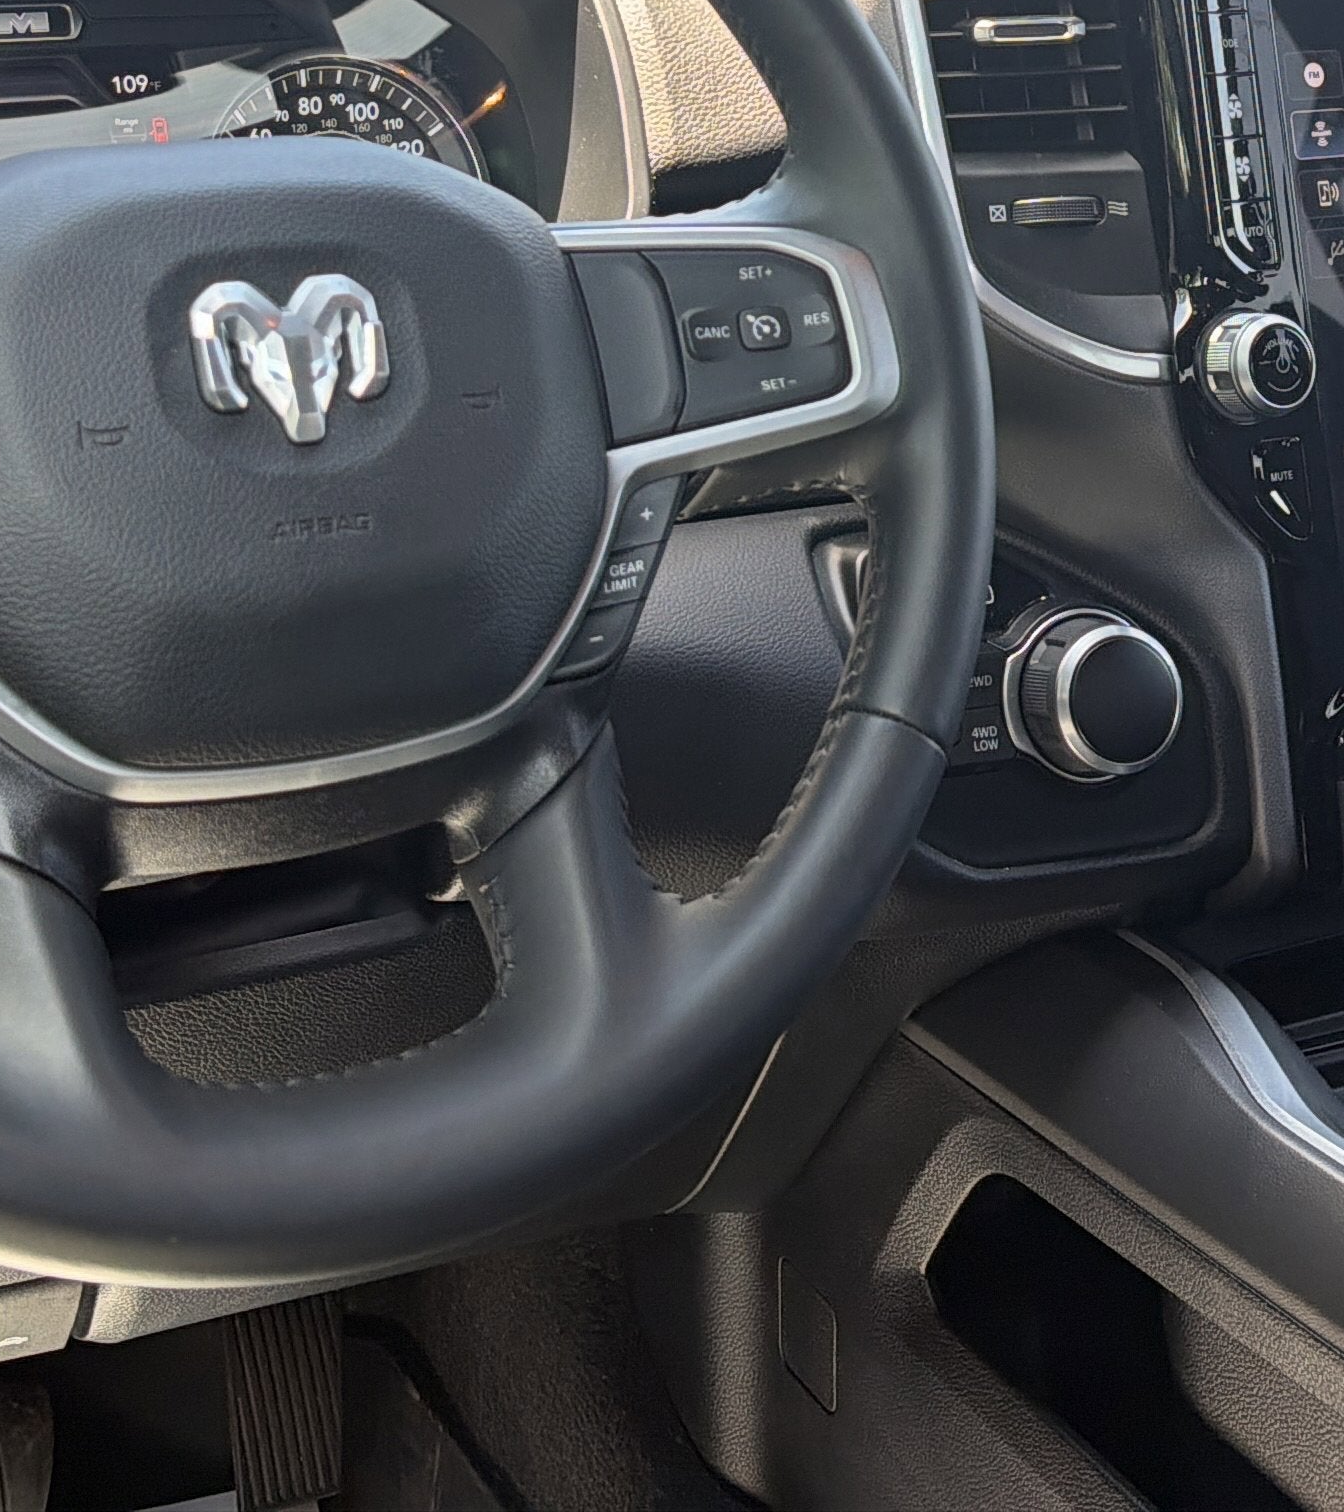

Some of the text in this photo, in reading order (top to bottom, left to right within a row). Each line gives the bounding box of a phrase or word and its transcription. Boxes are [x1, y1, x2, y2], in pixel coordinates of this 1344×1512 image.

[1220, 38, 1239, 49] ODE
[1308, 71, 1320, 80] FM
[298, 96, 322, 116] 80
[329, 93, 345, 106] 90
[274, 109, 289, 122] 70
[345, 101, 379, 123] 100
[291, 123, 308, 134] 120
[321, 117, 337, 129] 140
[354, 122, 371, 133] 160
[383, 118, 404, 131] 110
[375, 133, 393, 144] 180
[803, 311, 830, 326] RES
[694, 325, 731, 340] CANC
[1270, 470, 1294, 482] MUTE
[609, 559, 645, 577] GEAR
[603, 576, 638, 593] LIMIT
[971, 725, 998, 738] 4WD
[973, 738, 999, 752] LOW
